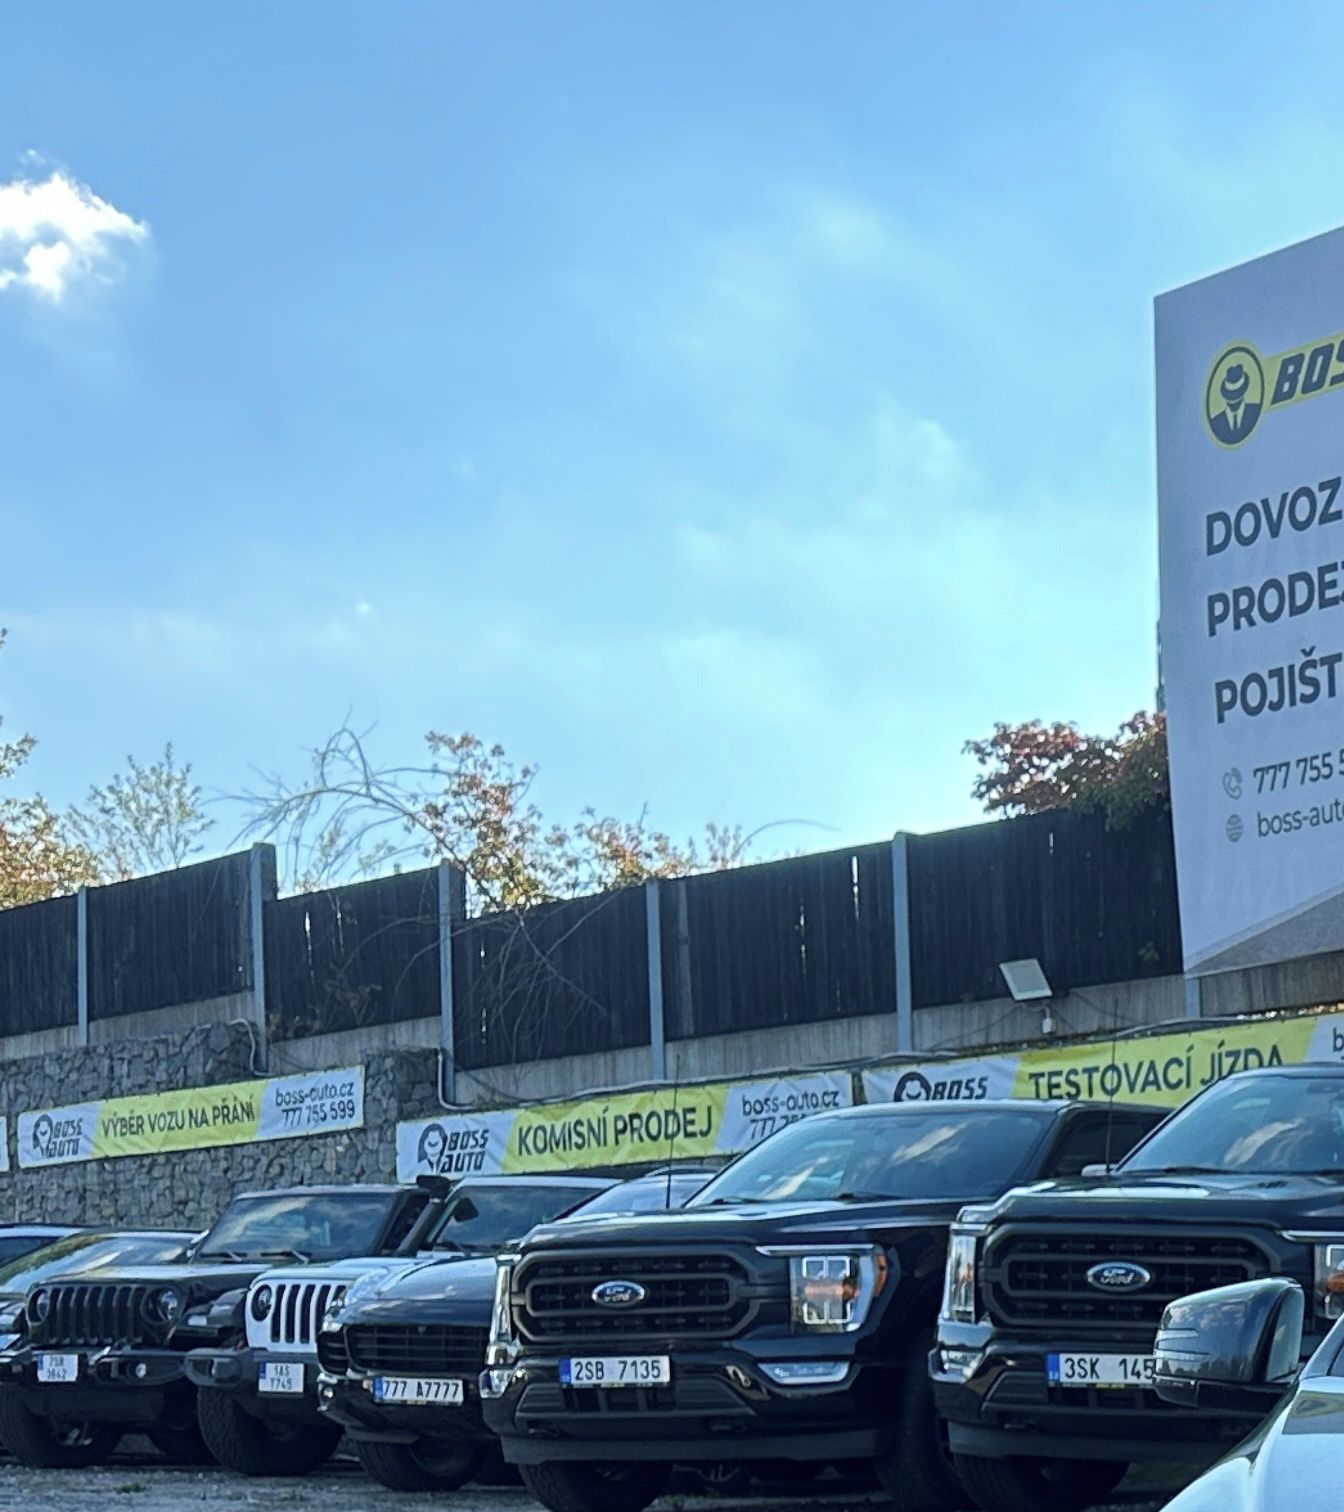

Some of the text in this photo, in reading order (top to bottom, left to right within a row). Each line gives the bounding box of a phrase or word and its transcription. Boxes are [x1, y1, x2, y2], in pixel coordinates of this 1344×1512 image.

[1206, 476, 1343, 557] DOVOZ
[1253, 761, 1291, 795] 777
[1296, 751, 1334, 786] 755
[1028, 1039, 1284, 1100] TESTOVACÍ JÍZDA
[275, 1082, 355, 1107] boss-auto.cz
[931, 1076, 989, 1100] BOSS
[281, 1099, 356, 1128] 777 755 599
[742, 1090, 840, 1116] boss-auto.cz
[53, 1117, 83, 1139] BOSS
[101, 1094, 256, 1138] VÝBĚR VOZU NA PŘÁNÍ
[448, 1128, 490, 1152] BOSS
[518, 1104, 713, 1157] KOMISNÍ PRODEJ
[440, 1150, 486, 1174] AUTO
[574, 1359, 661, 1381] 2SB 7135
[1064, 1357, 1100, 1380] 3SK
[383, 1379, 460, 1400] 777 A7777
